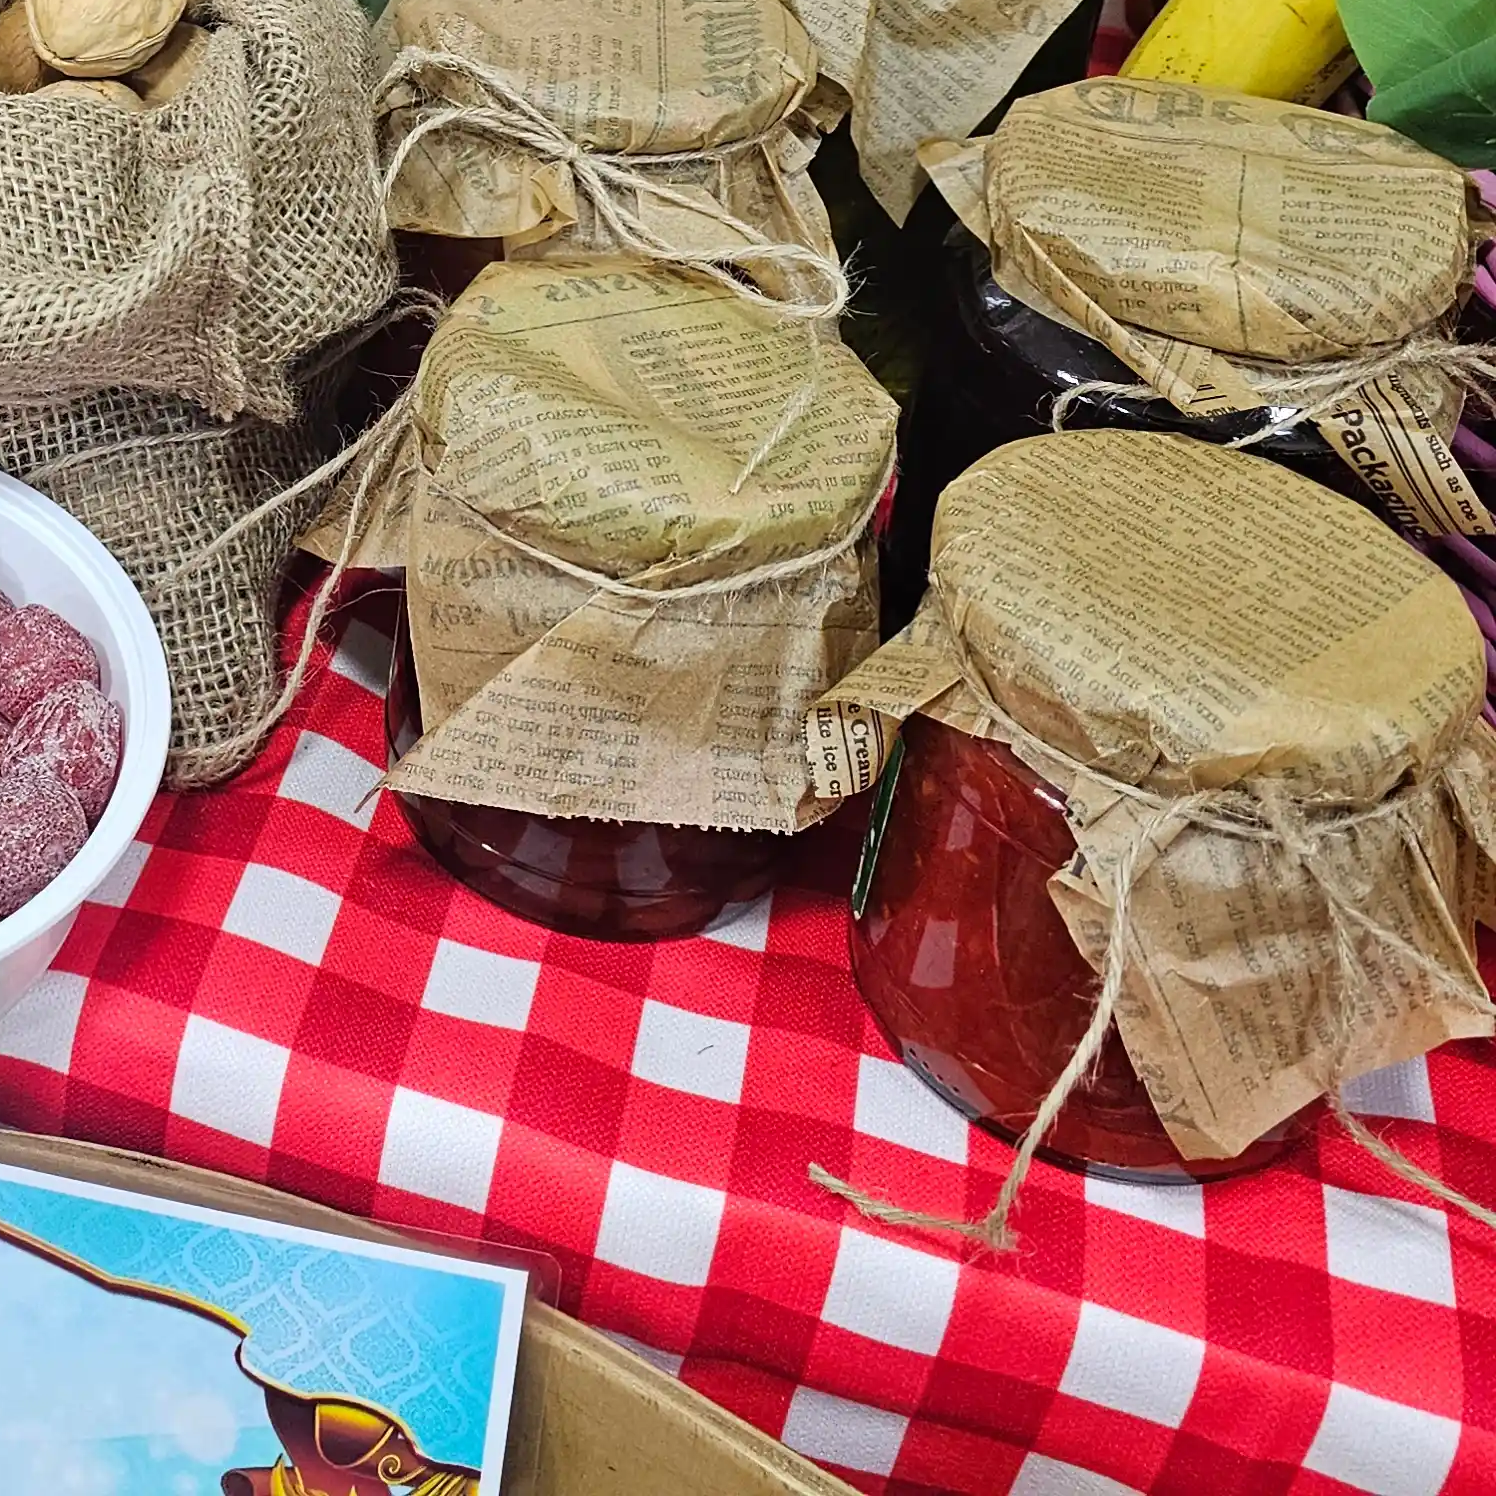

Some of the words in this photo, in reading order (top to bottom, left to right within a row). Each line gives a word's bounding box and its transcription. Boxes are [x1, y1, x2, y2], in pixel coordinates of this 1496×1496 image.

[1425, 435, 1453, 472] such
[1446, 476, 1463, 493] as
[1457, 499, 1477, 522] roe
[822, 745, 839, 772] ice
[850, 718, 870, 790] Cream
